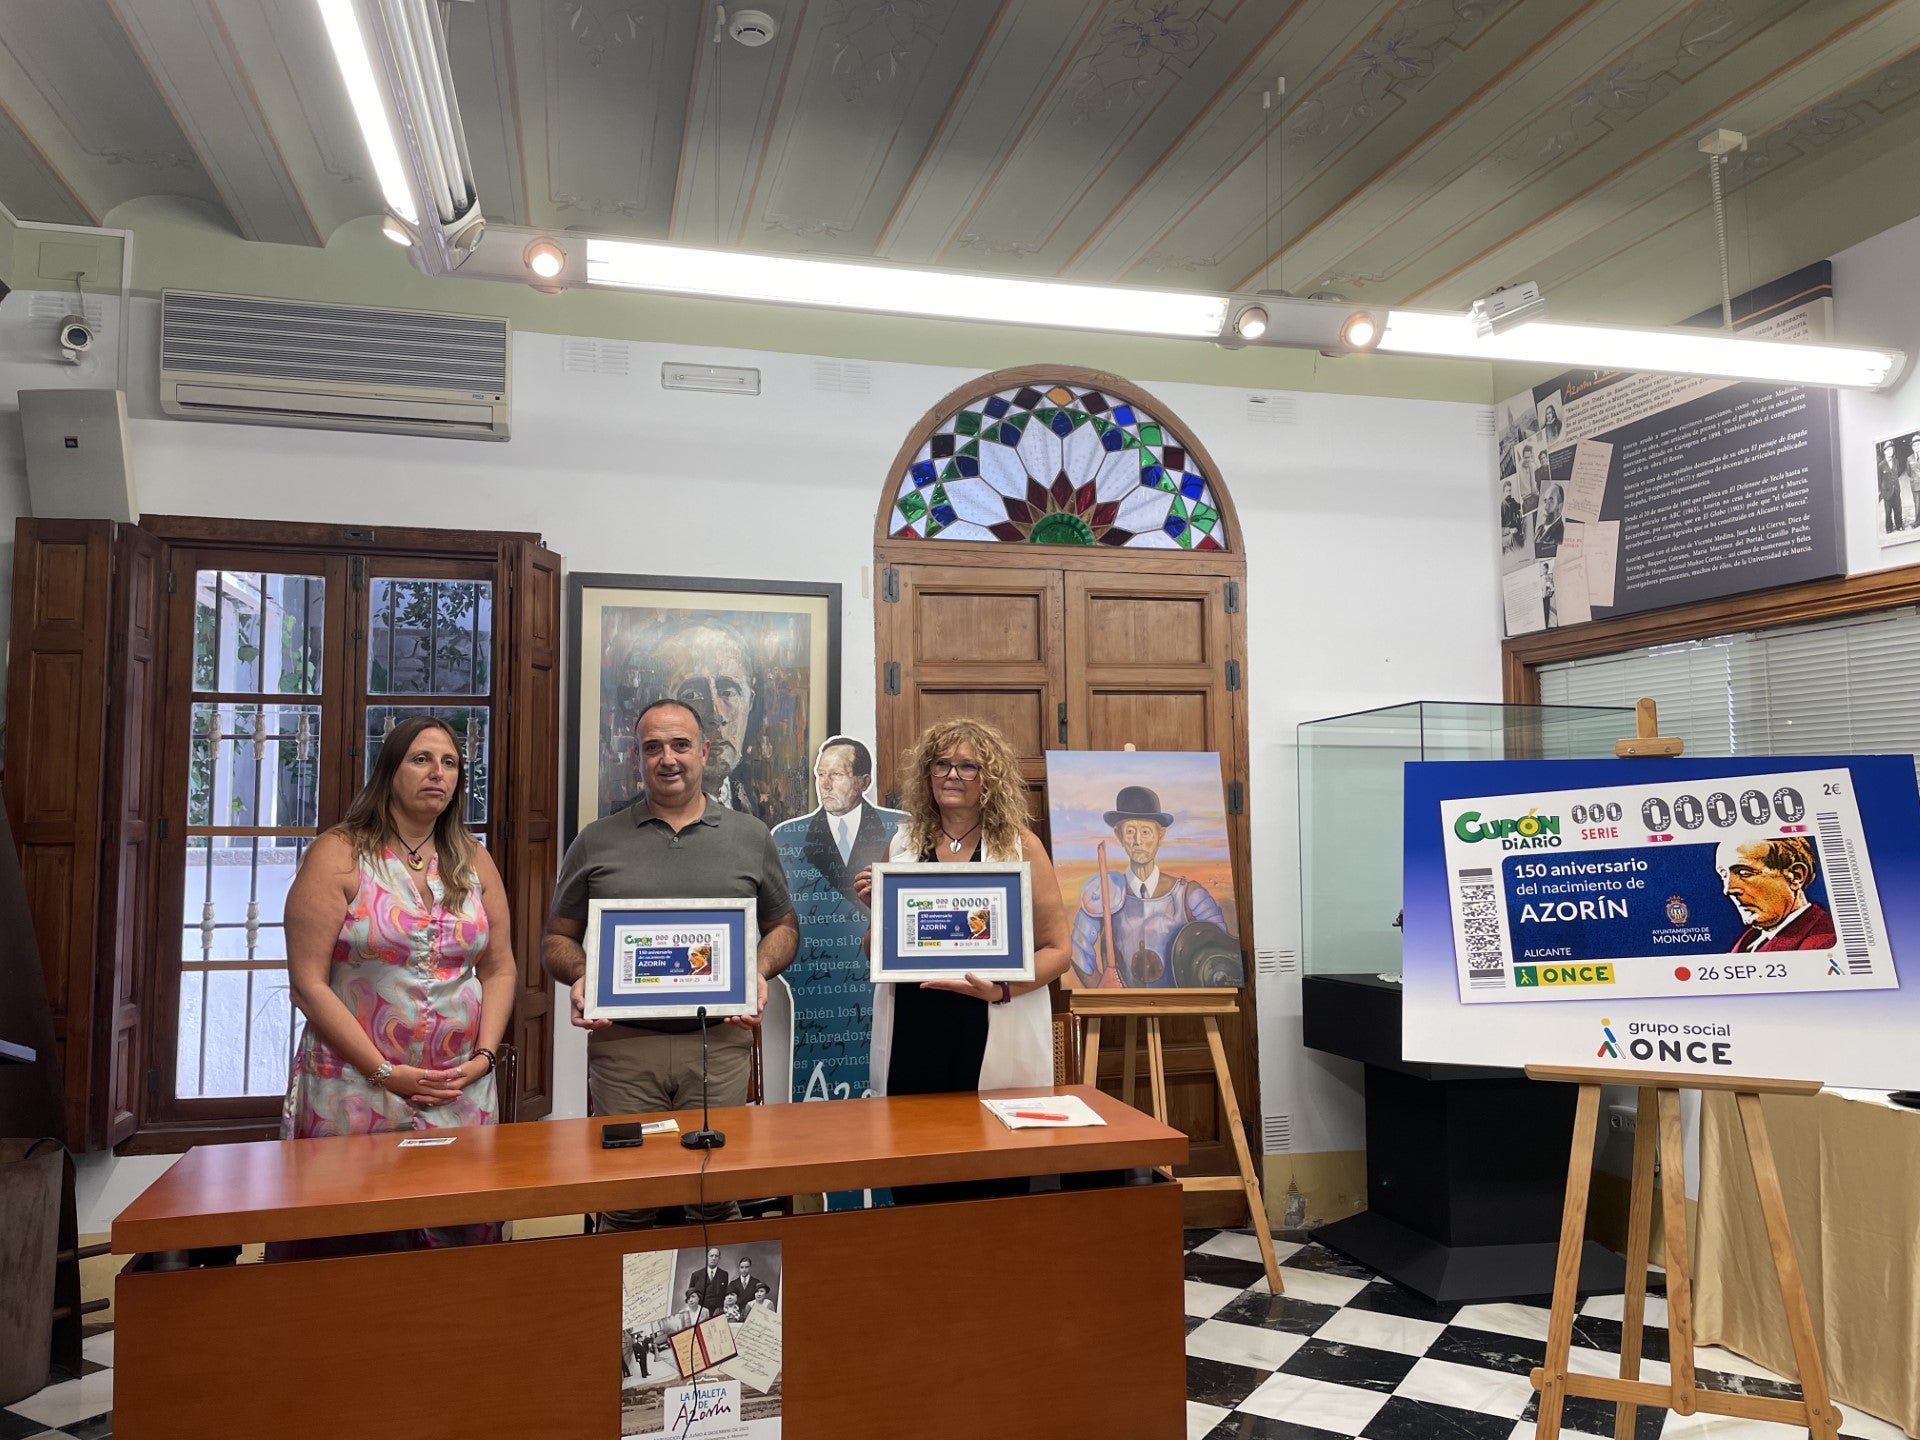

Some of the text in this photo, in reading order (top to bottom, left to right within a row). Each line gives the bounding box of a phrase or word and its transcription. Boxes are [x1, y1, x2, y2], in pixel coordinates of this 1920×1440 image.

[1571, 802, 1622, 824] 000
[1641, 786, 1806, 832] 00000
[1823, 783, 1841, 796] 2€
[1581, 826, 1618, 840] SERIE
[1514, 858, 1648, 878] 150 aniversario
[1516, 876, 1645, 896] del nacimiento de
[1520, 896, 1628, 924] AZORÍN
[800, 912, 846, 925] huerta
[920, 922, 946, 930] AZORÍN
[804, 936, 833, 948] Pero
[836, 935, 848, 946] si
[1652, 931, 1712, 944] MONÓVAR
[1524, 948, 1572, 958] ALICANTE
[808, 961, 860, 974] riqueza
[1543, 966, 1610, 982] ONCE
[1698, 966, 1720, 981] 26
[1767, 964, 1788, 978] 23
[838, 1006, 856, 1018] los
[1629, 1022, 1731, 1036] grupo social
[1630, 1038, 1732, 1065] ONCE
[680, 1388, 726, 1402] LA MALETA
[698, 1401, 708, 1410] DE
